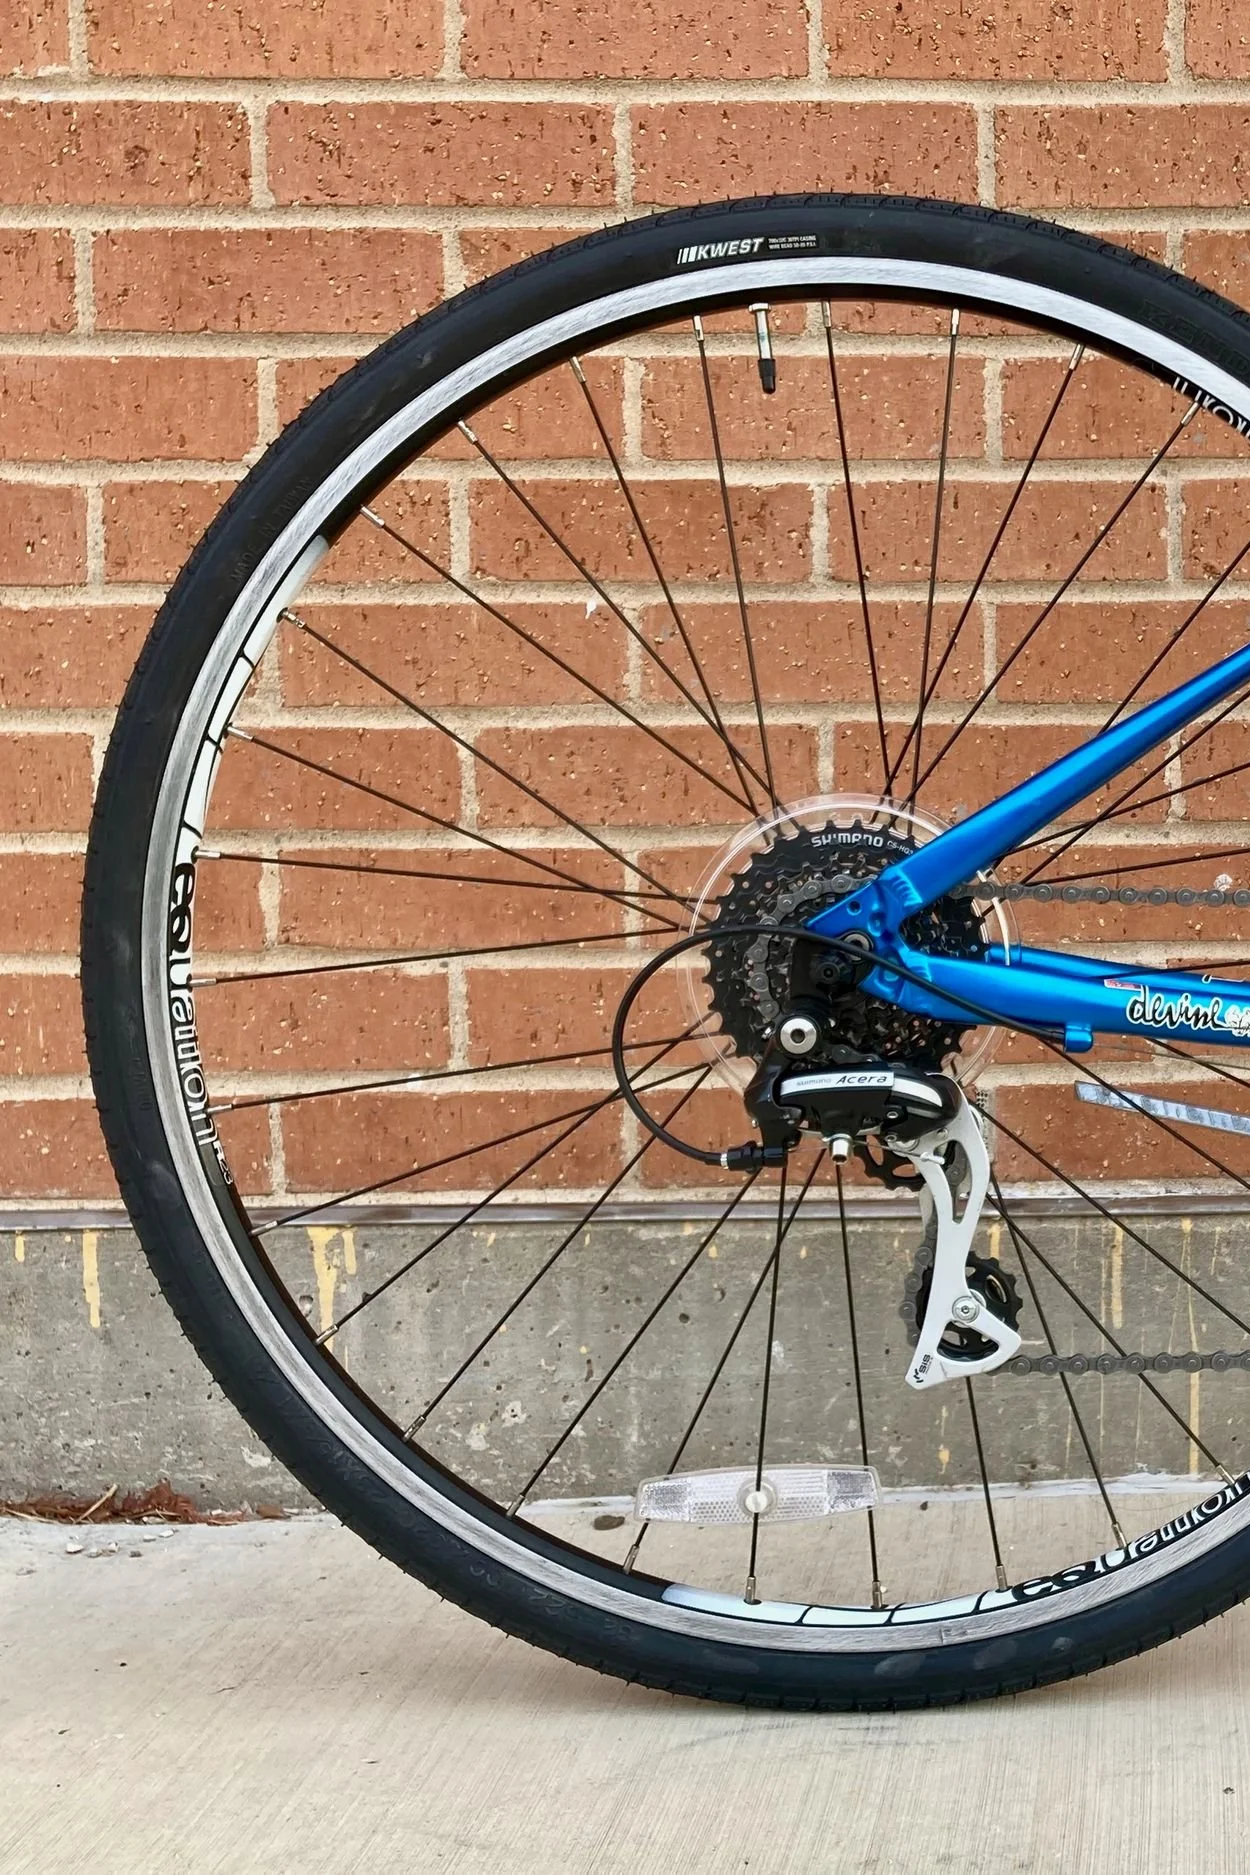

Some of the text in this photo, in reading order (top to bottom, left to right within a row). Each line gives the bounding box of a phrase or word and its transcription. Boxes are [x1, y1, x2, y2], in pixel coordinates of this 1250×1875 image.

[696, 237, 765, 261] KWEST
[811, 833, 883, 848] SHIMANO
[167, 861, 219, 1146] equation
[1126, 984, 1240, 1030] devine
[836, 1073, 888, 1085] Acera
